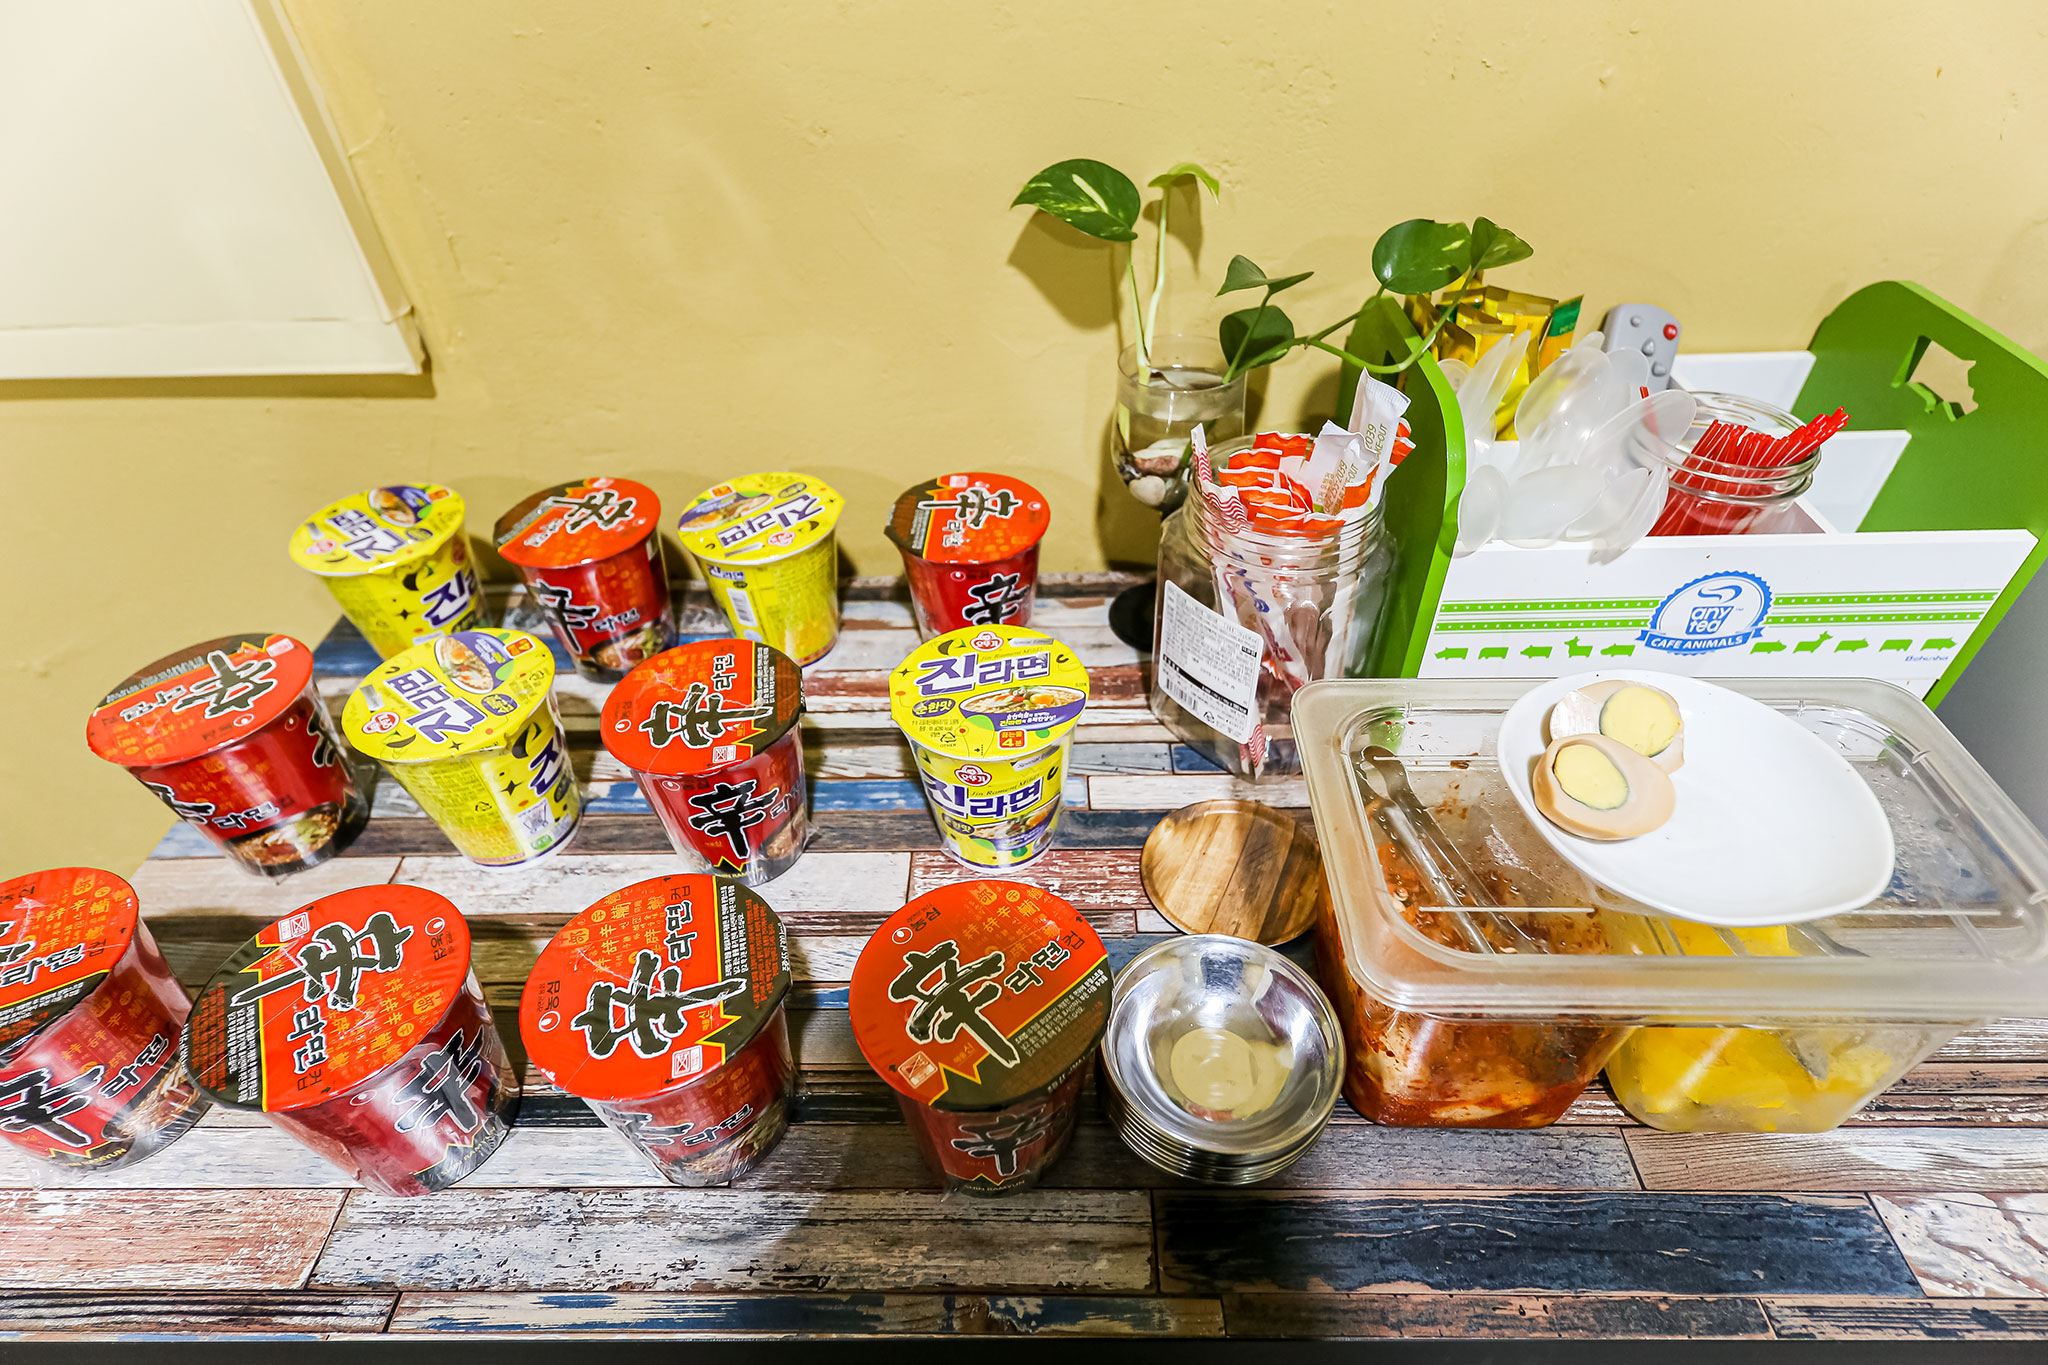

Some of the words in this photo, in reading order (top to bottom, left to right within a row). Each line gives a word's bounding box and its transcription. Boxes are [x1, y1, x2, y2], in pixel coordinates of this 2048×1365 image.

[918, 486, 1023, 529] 辛
[1651, 637, 1681, 650] CAFE
[1682, 635, 1743, 650] ANIMALS
[1688, 619, 1721, 633] tea
[1691, 606, 1732, 621] any
[172, 650, 278, 720] 辛
[711, 653, 737, 693] 라면
[914, 651, 1052, 697] 진라면
[384, 666, 488, 745] 진라면
[638, 682, 774, 748] 辛
[212, 801, 280, 829] 라면
[688, 779, 779, 860] 辛
[920, 767, 1044, 819] 진라면
[230, 911, 414, 1012] 辛
[663, 900, 701, 963] 라면
[1004, 940, 1070, 994] 라면
[570, 948, 748, 1060] 辛
[888, 939, 1021, 1069] 辛
[98, 1033, 169, 1099] 라면
[286, 1004, 329, 1075] 라면
[0, 1064, 106, 1148] 辛
[391, 1025, 484, 1134] 辛
[681, 1104, 753, 1147] 라면
